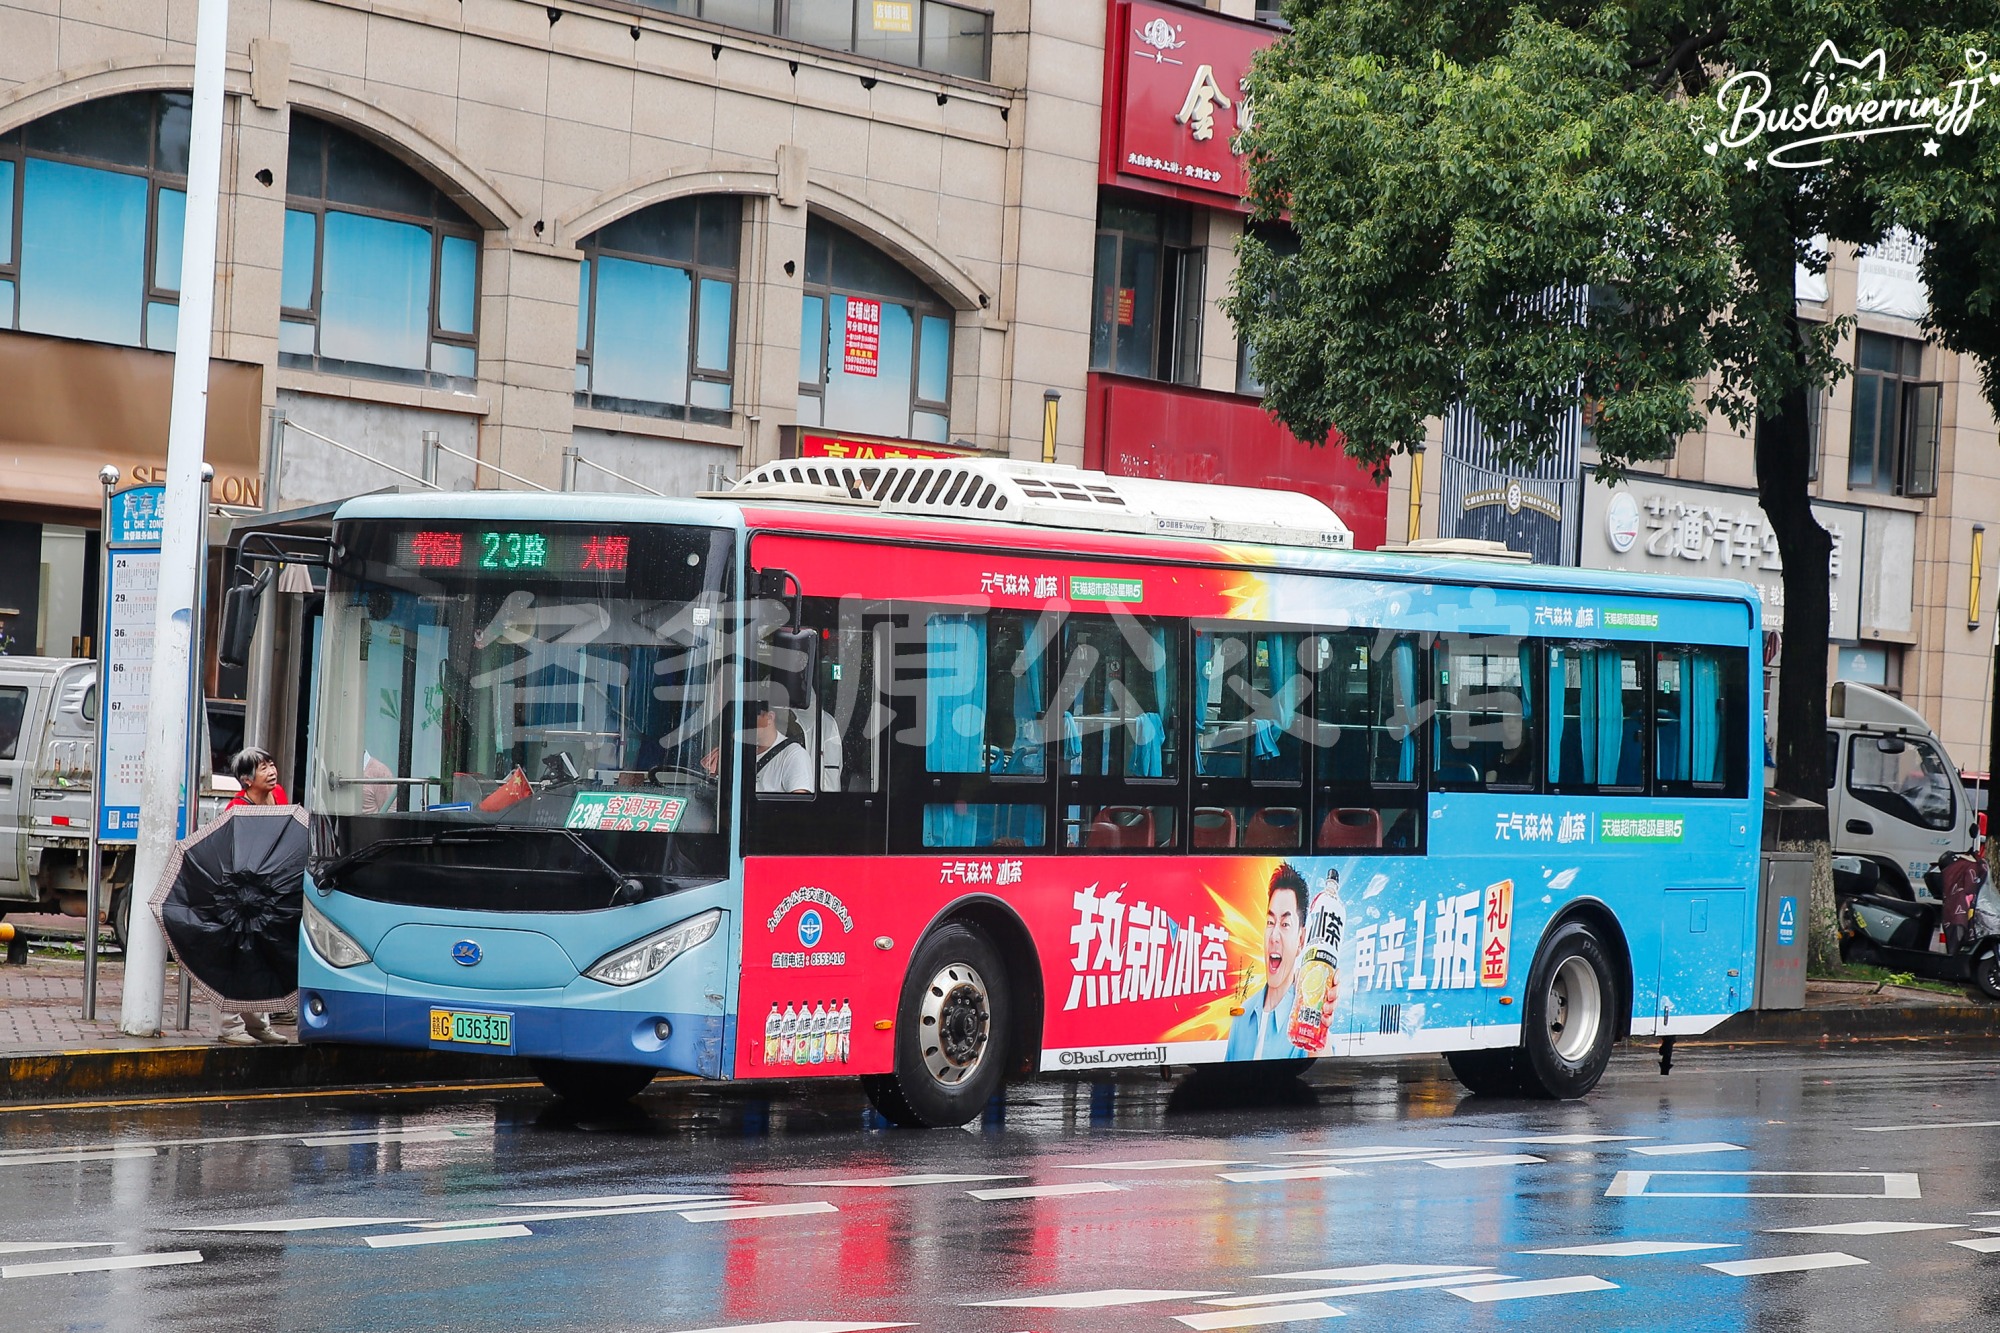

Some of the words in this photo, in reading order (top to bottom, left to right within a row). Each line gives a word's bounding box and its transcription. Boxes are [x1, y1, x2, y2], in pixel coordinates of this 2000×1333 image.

[847, 301, 879, 322] 旺铺出租
[1464, 491, 1506, 506] CHINATEA
[1522, 495, 1561, 517] CHINATEA
[134, 520, 145, 529] CHE
[116, 559, 127, 568] 24
[482, 533, 546, 568] 23路
[581, 535, 630, 570] 大桥
[980, 572, 1030, 596] 元气森林
[1033, 574, 1058, 598] 冰茶
[1071, 581, 1141, 598] 天猫超市超级星期5
[115, 593, 126, 602] 29
[1534, 606, 1573, 626] 元气森林
[1575, 606, 1594, 628] 冰茶
[1604, 611, 1658, 627] 天猫超市超级星期5
[114, 628, 125, 637] 36
[113, 663, 124, 672] 66
[111, 701, 121, 710] 67
[604, 797, 681, 821] 空调开启
[1495, 811, 1553, 842] 元气森林
[1556, 811, 1586, 844] 冰茶
[1601, 818, 1683, 838] 天猫超市超级星期5
[939, 862, 993, 884] 元气森林
[996, 860, 1022, 885] 冰茶
[766, 886, 855, 934] 九江市公共交通集团公司
[1063, 881, 1229, 1011] 热就冰茶
[1354, 890, 1480, 991] 再来1瓶
[1483, 888, 1508, 980] 礼金
[772, 951, 846, 969] 监督电话：8553416
